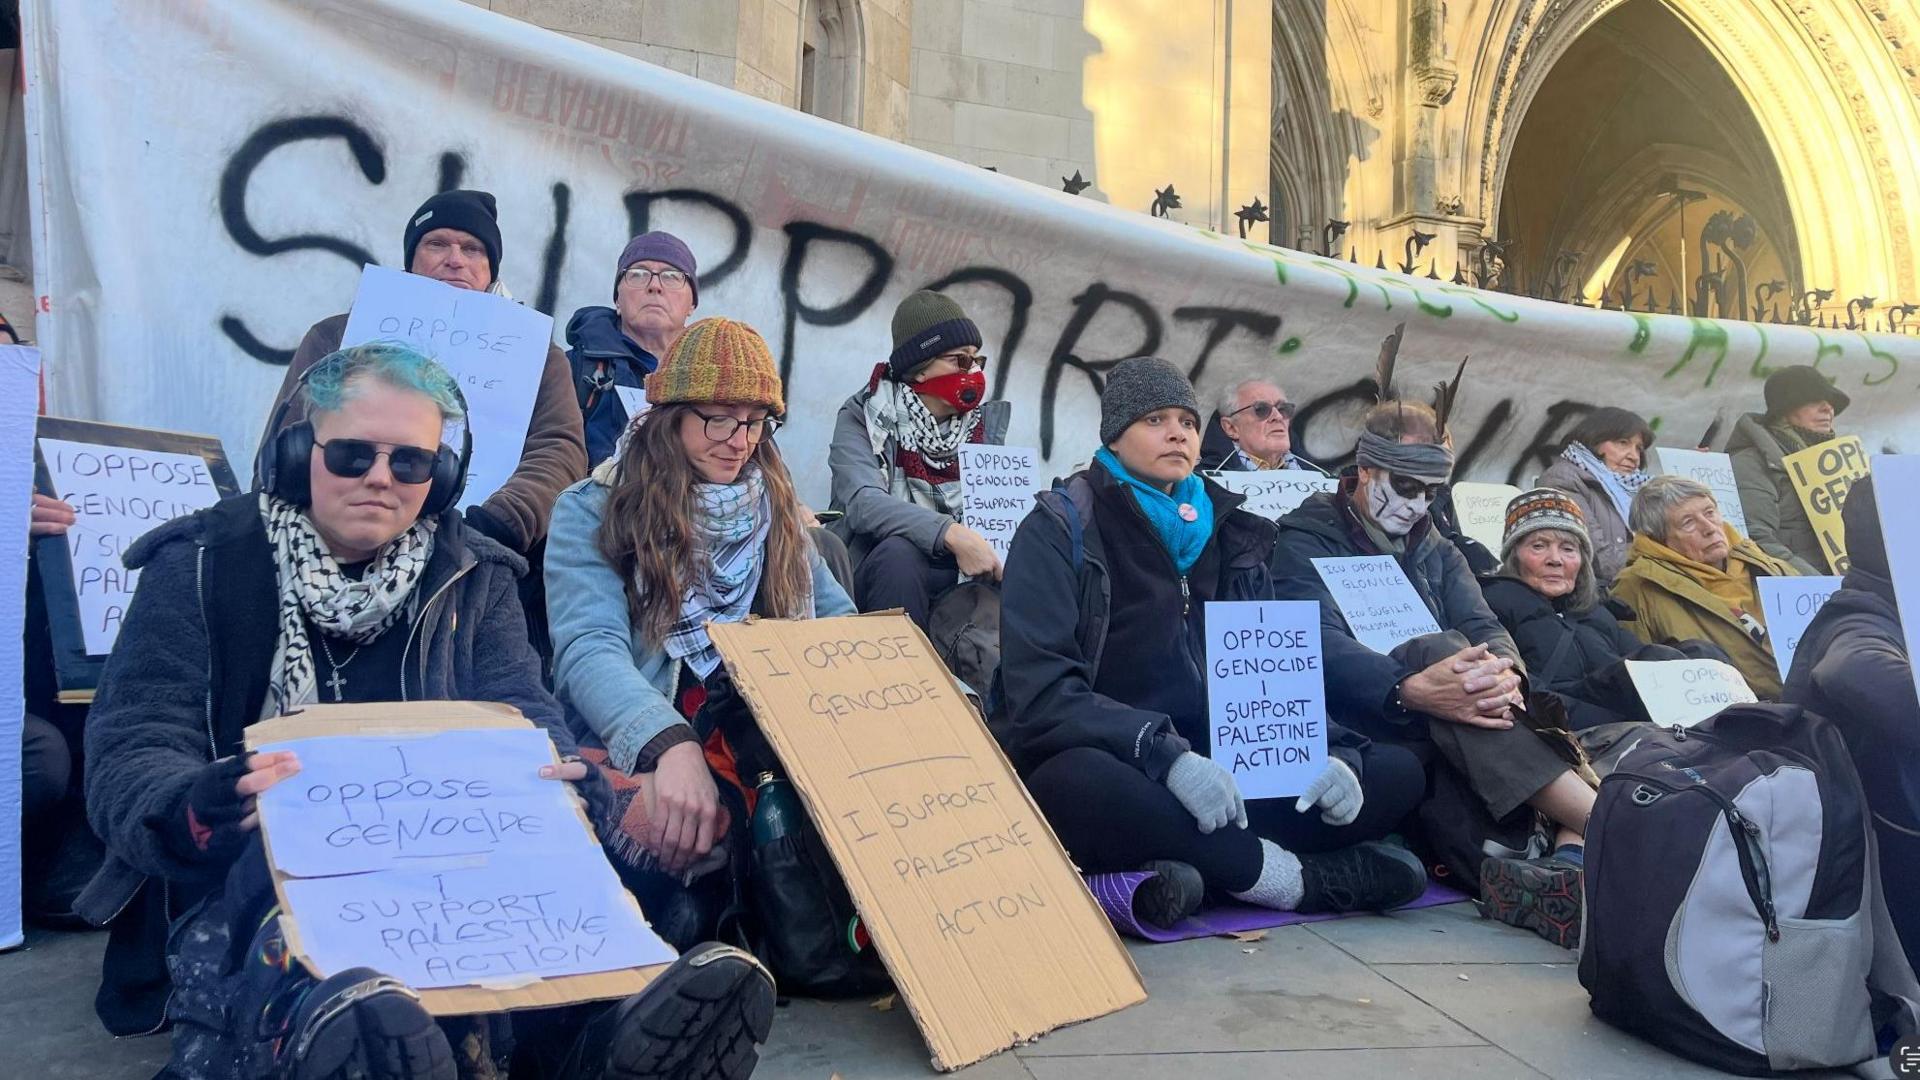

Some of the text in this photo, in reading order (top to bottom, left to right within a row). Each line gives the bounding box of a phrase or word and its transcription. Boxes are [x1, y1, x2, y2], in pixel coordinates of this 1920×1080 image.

[379, 317, 522, 353] OPPOSE
[57, 451, 211, 486] I OPPOSE
[960, 451, 1032, 470] I OPPOSE
[1792, 461, 1808, 487] I
[966, 473, 1031, 493] GENOCIDE
[1260, 607, 1264, 623] I
[1777, 592, 1782, 616] I
[1223, 629, 1308, 651] OPPOSE
[1353, 620, 1398, 632] PALESTINE
[752, 636, 919, 676] I OPPOSE
[1215, 656, 1318, 679] GENOCIDE
[809, 680, 941, 724] GENOCIDE
[1261, 680, 1266, 696] I
[1226, 699, 1311, 723] SUPPORT
[1217, 722, 1319, 747] PALESTINE
[392, 746, 411, 778] I
[1232, 746, 1310, 774] ACTION
[307, 779, 492, 820] OPPOSE
[843, 782, 999, 842] I SUPPORT
[326, 808, 544, 850] GENOCIDE
[894, 821, 1032, 882] PALESTINE
[433, 874, 447, 900] I
[338, 891, 556, 925] SUPPORT
[936, 883, 1045, 941] ACTION
[381, 908, 608, 960] PALESTINE
[425, 938, 606, 982] ACTION
